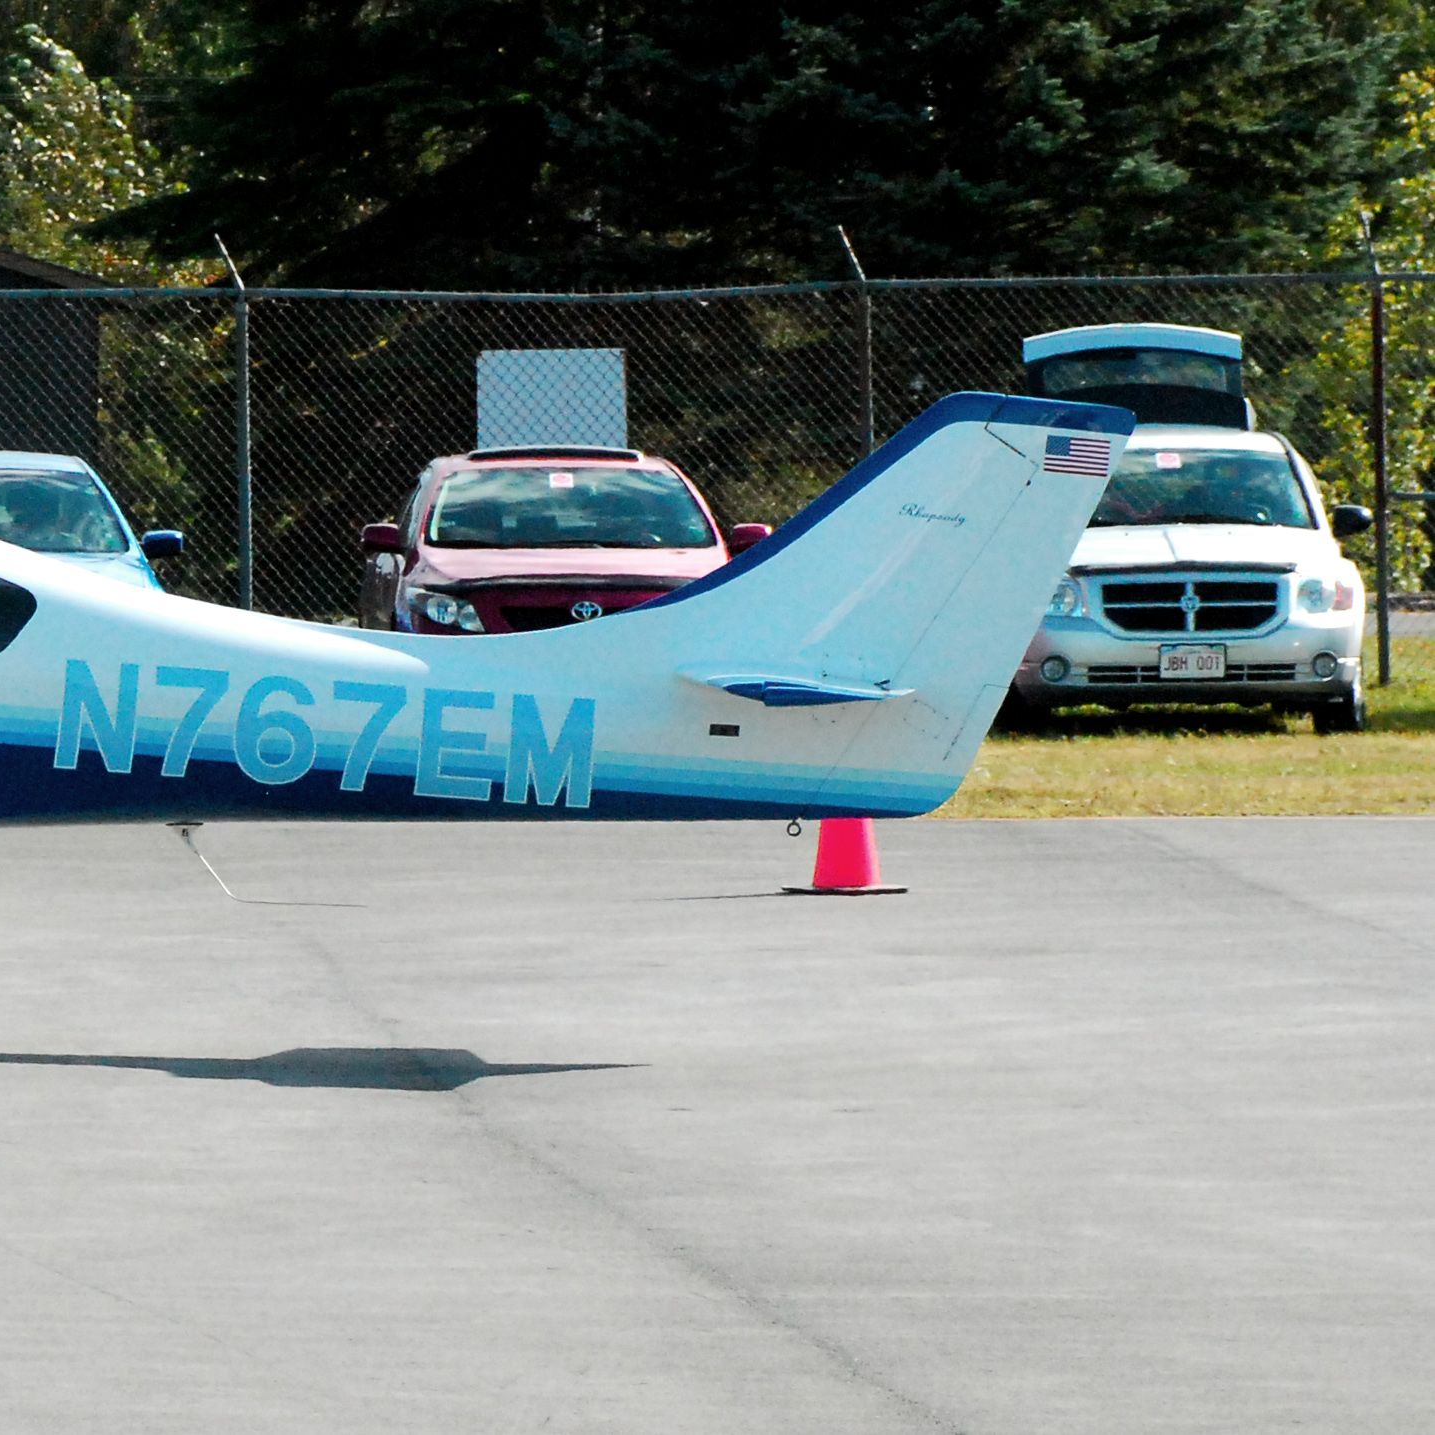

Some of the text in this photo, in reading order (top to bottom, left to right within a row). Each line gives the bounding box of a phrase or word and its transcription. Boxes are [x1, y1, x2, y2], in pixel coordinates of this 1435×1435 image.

[899, 503, 965, 527] Rhapsody
[1164, 656, 1219, 671] JBH 001
[53, 659, 595, 808] N767EM
